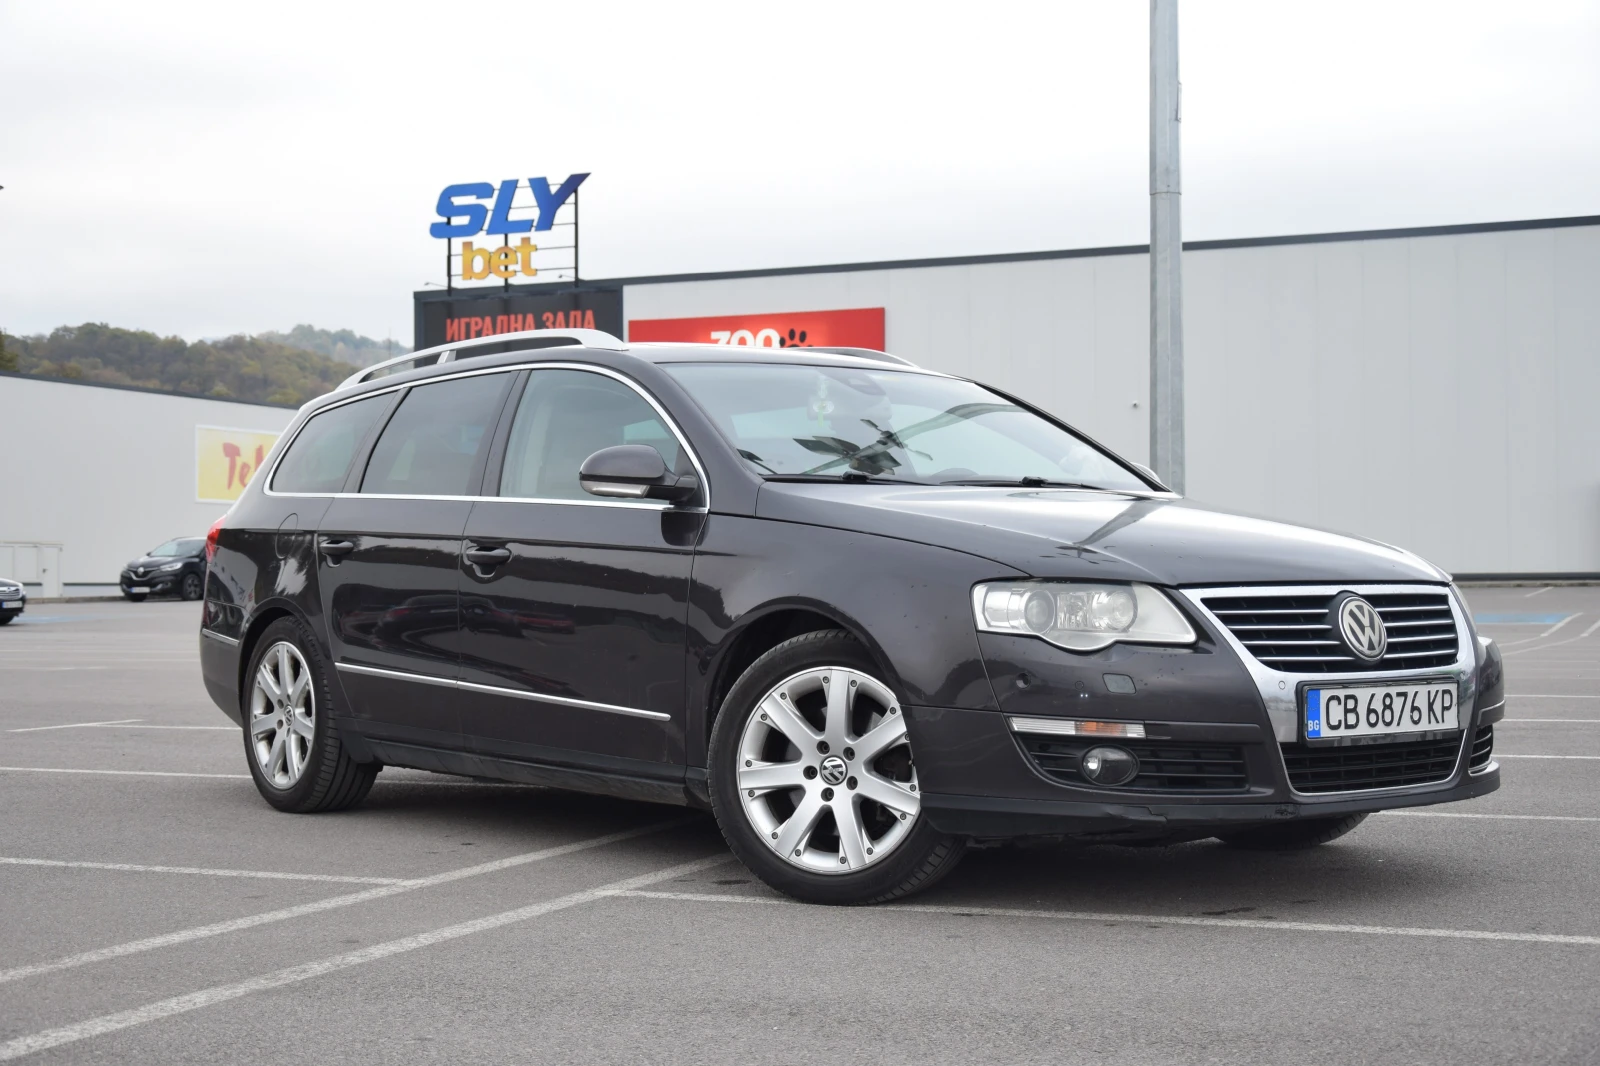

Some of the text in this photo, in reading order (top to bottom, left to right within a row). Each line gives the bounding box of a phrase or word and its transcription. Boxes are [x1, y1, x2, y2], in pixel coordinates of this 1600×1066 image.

[429, 172, 591, 239] SLY
[462, 237, 537, 280] bet
[446, 309, 596, 342] ИГРАЛНА ЗАЛА
[1307, 719, 1320, 732] BG
[1325, 688, 1453, 731] CB 6876 KP
